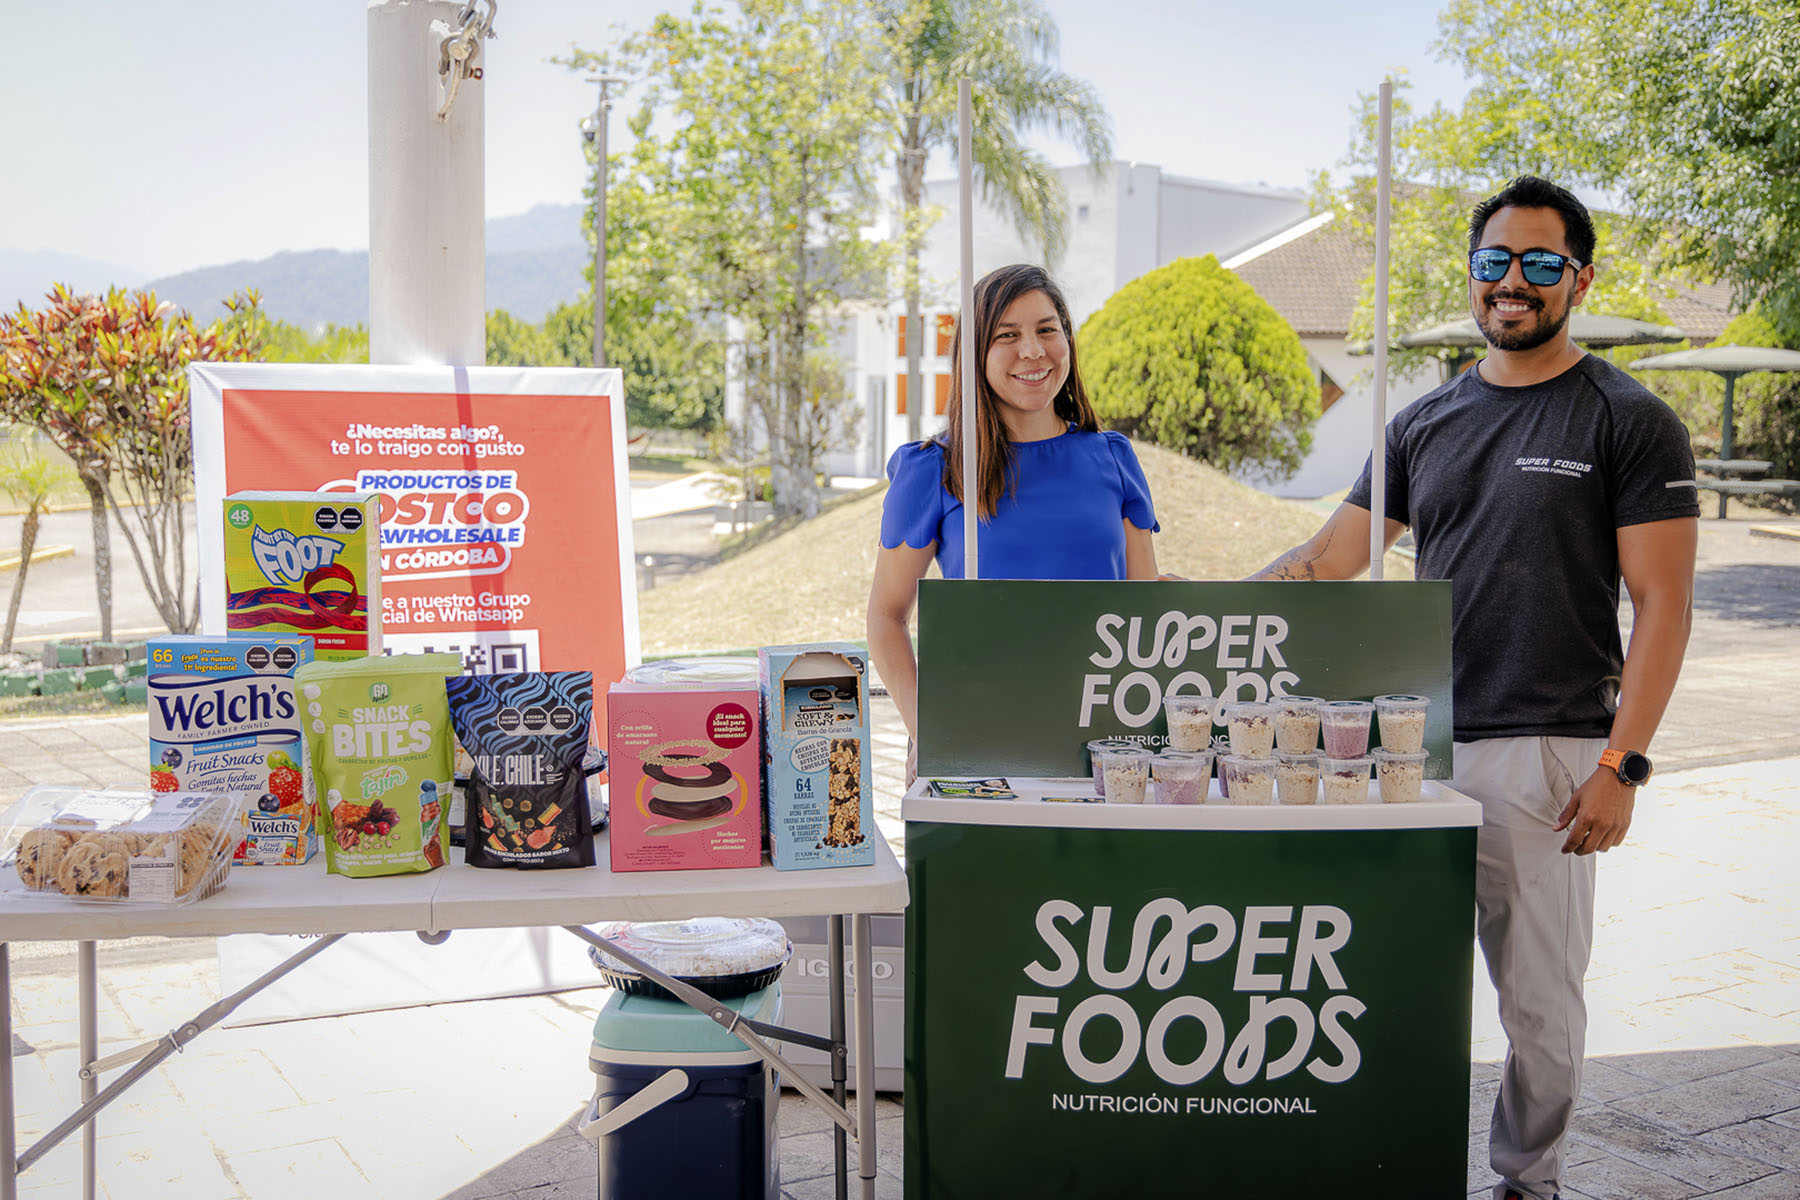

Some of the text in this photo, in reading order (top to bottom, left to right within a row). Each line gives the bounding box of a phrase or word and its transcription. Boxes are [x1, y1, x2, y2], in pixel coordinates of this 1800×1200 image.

[346, 424, 447, 439] ¿Necesitas
[330, 440, 525, 458] te lo traigo con gusto
[1515, 457, 1592, 473] SUPER FOODS
[1550, 467, 1582, 478] FUNCIONAL
[361, 475, 512, 489] PRODUCTOS DE
[230, 510, 249, 521] 48
[380, 492, 524, 525] STCO
[383, 528, 520, 543] WHOLESALE
[252, 537, 343, 585] FOOT
[395, 548, 498, 569] CÓRDOBA
[397, 597, 407, 608] a
[412, 594, 475, 608] nuestro
[478, 592, 531, 609] Grupo
[413, 609, 435, 622] de
[438, 608, 523, 624] Whatsapp
[1089, 610, 1289, 669] SUPER
[153, 649, 173, 662] 66
[153, 684, 295, 731] Welch's
[352, 704, 410, 723] SNACK
[796, 711, 834, 721] SOFT &
[178, 722, 270, 740] FAMILY FARMER OWNED
[794, 719, 834, 728] CHEWY
[333, 720, 431, 758] BITES
[186, 753, 264, 775] Fruit Snacks
[188, 771, 257, 790] Gomitas hechas
[226, 780, 266, 792] Natural
[796, 777, 811, 792] 64
[1023, 897, 1352, 991] SUPER
[1005, 994, 1367, 1085] FOODS
[1052, 1093, 1316, 1114] NUTRICIÓN FUNCIONAL
